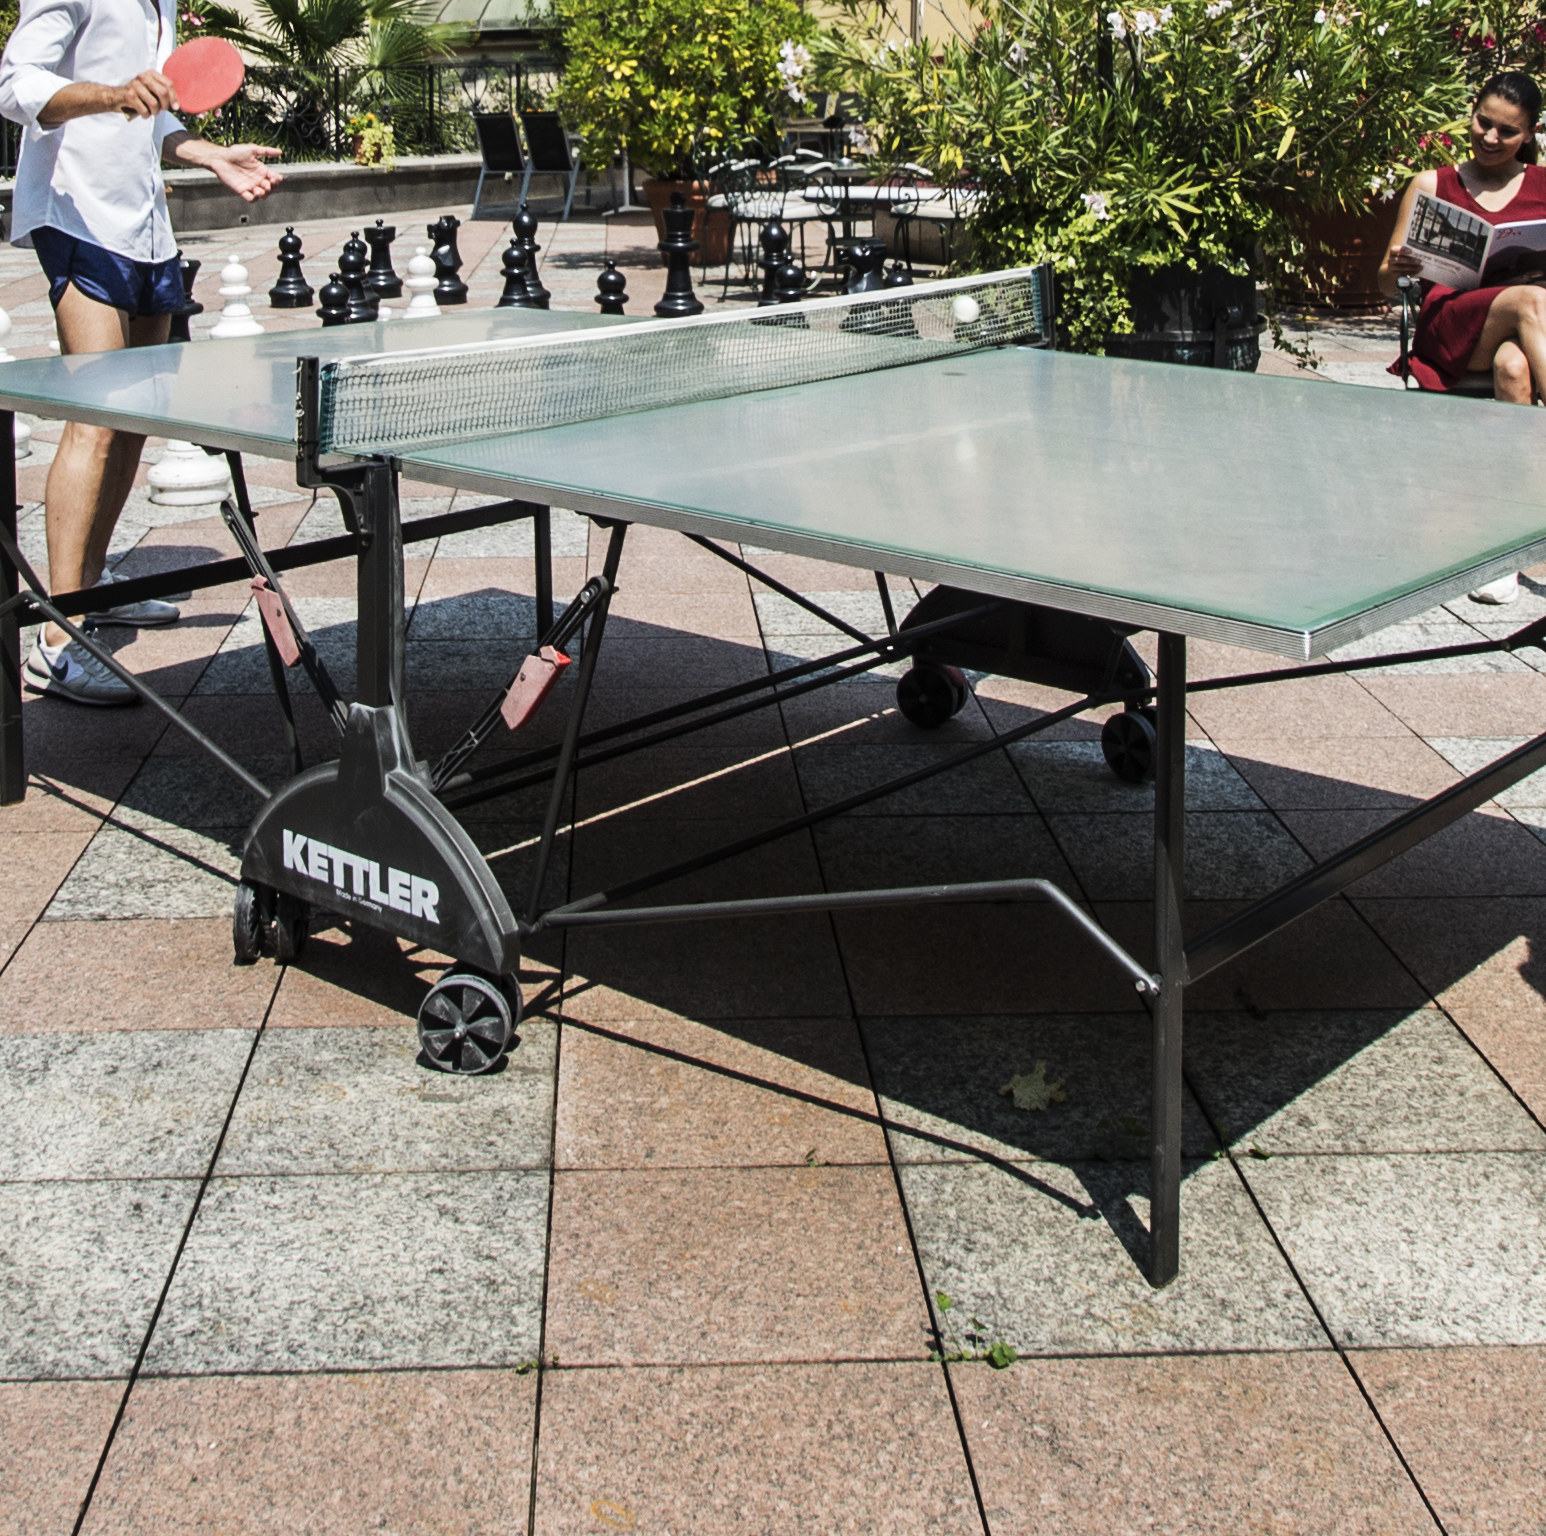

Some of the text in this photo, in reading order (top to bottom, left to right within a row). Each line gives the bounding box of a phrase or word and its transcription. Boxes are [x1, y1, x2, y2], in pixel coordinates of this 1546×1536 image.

[284, 829, 439, 923] KETTLER
[335, 888, 352, 901] Made
[358, 896, 382, 913] Germany
